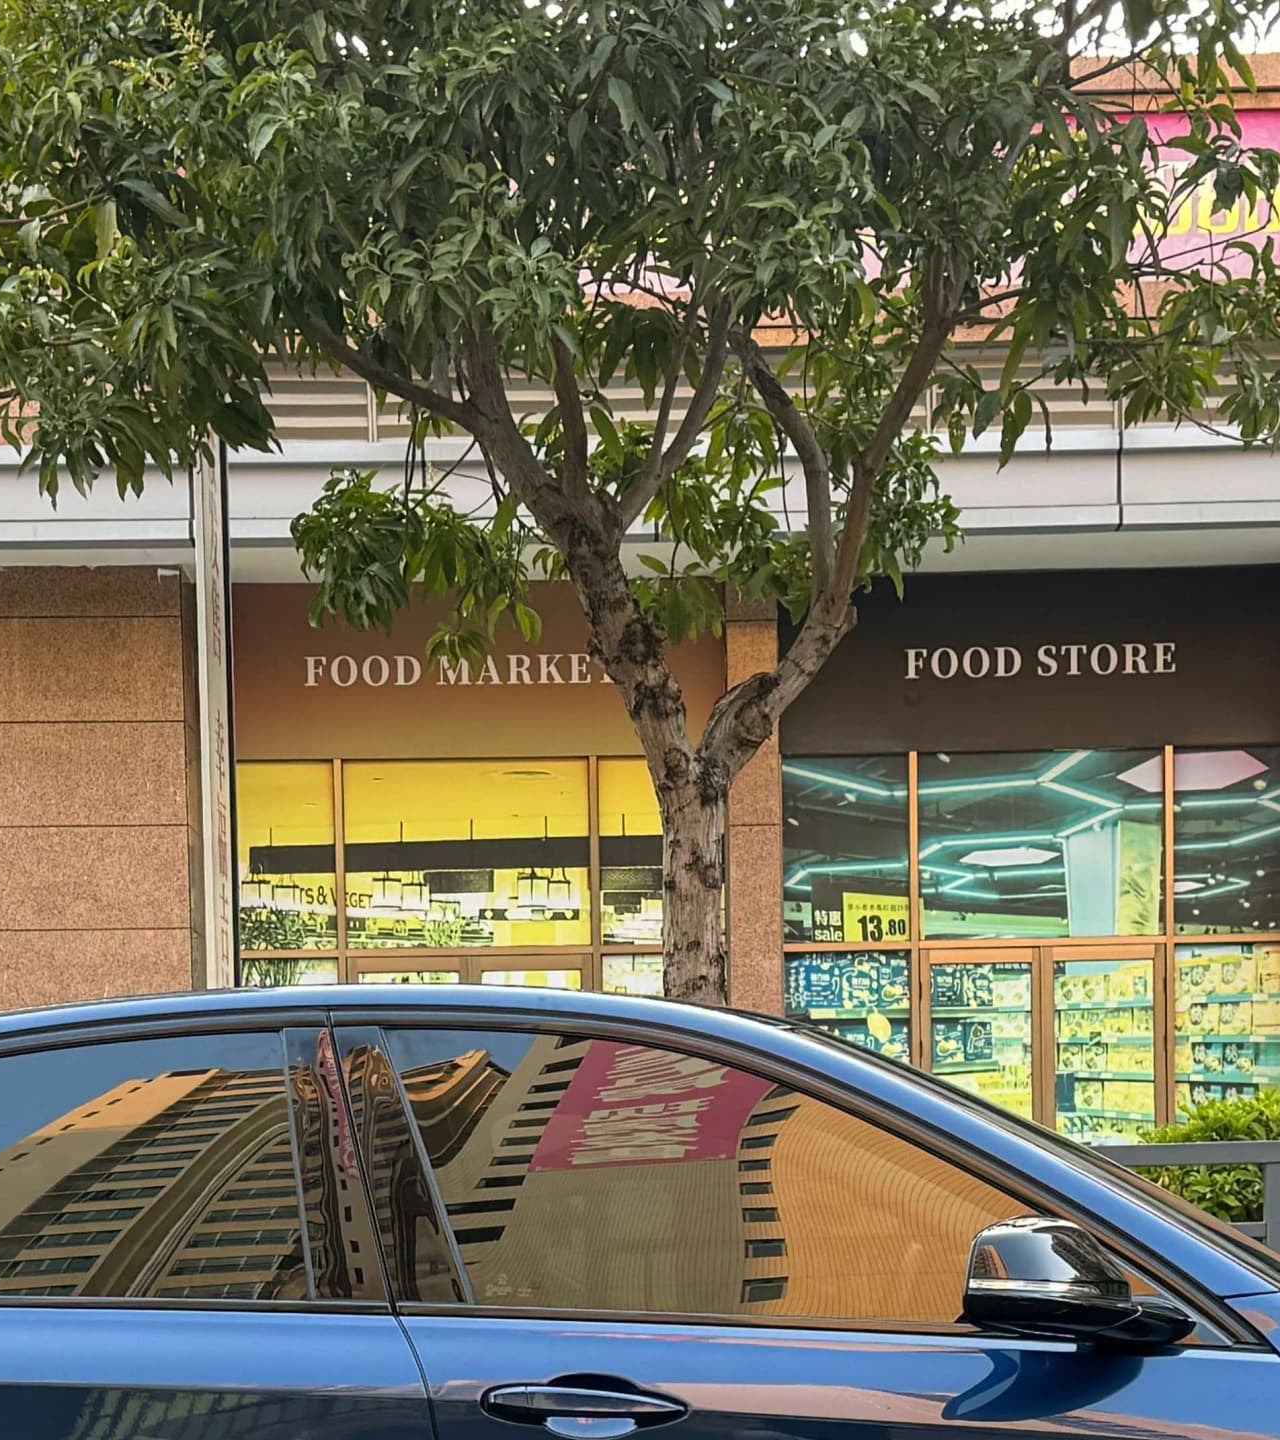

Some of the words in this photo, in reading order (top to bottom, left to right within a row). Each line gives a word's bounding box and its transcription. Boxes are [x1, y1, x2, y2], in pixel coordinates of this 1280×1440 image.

[303, 654, 422, 688] FOOD
[436, 653, 615, 686] MARKE
[904, 646, 1023, 681] FOOD
[1036, 641, 1177, 678] STORE
[814, 926, 843, 942] sale
